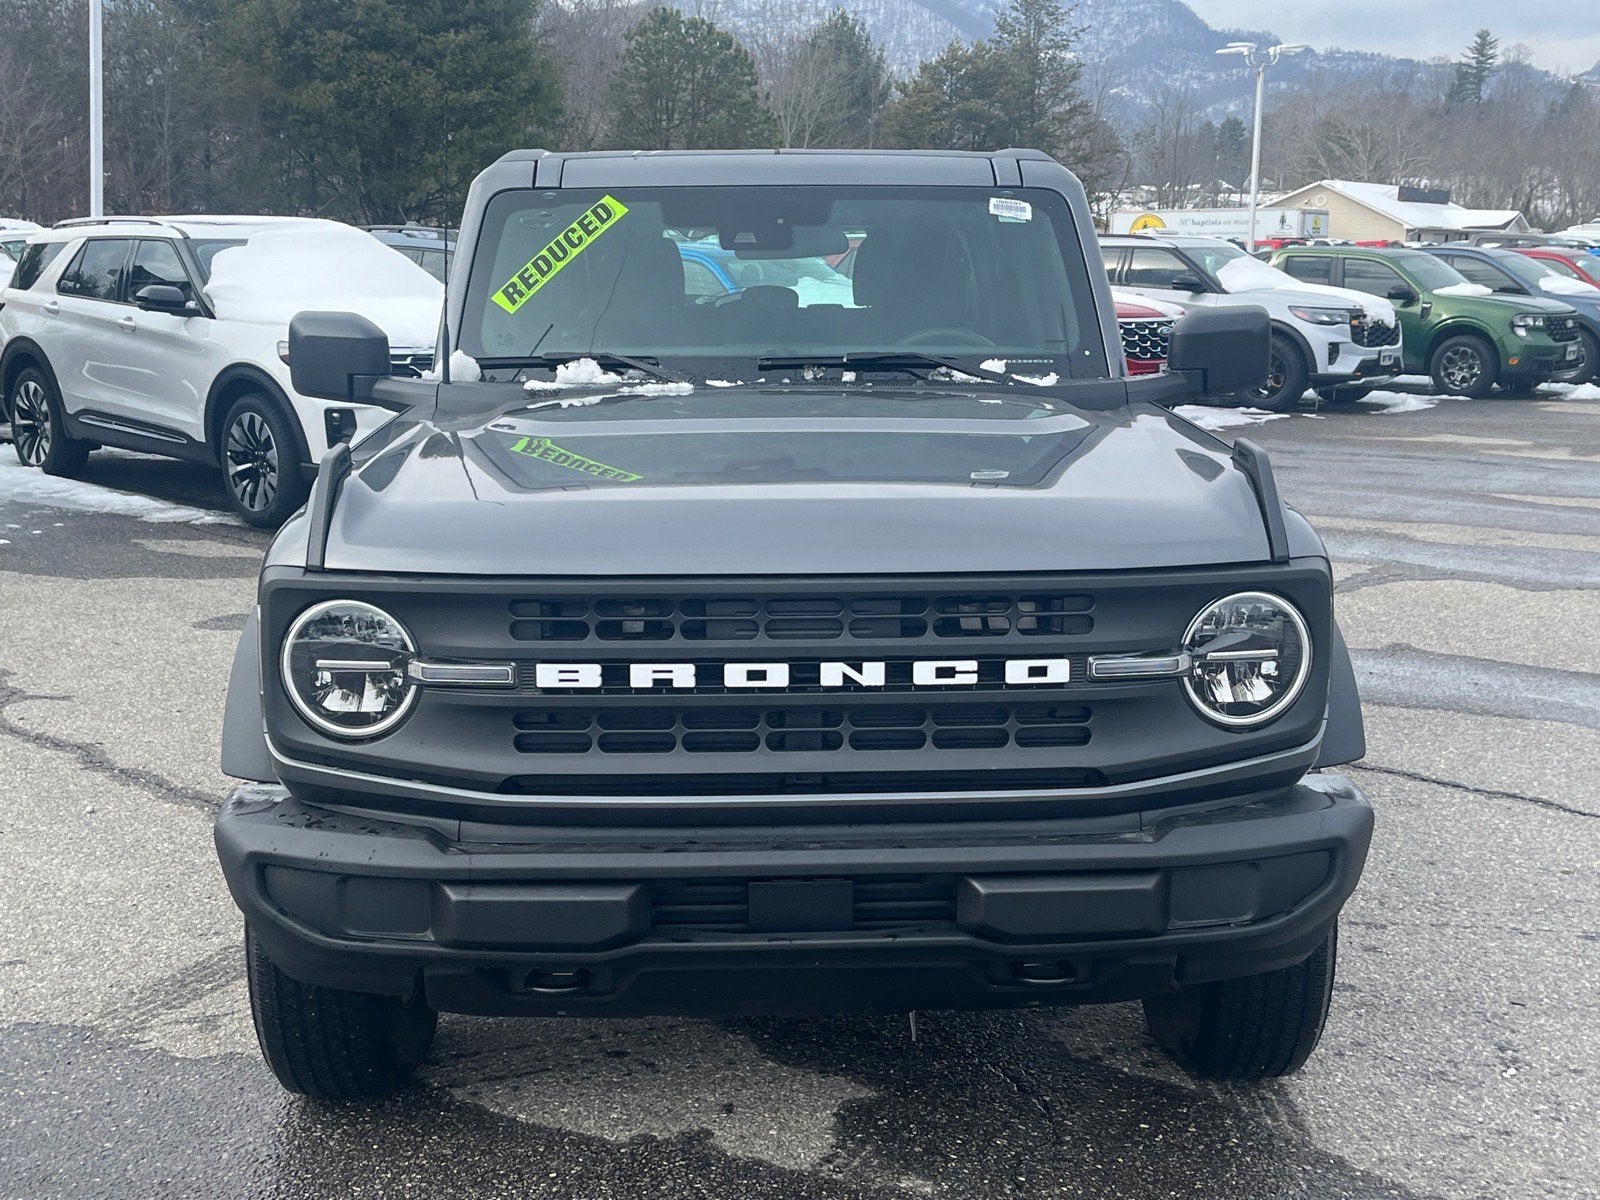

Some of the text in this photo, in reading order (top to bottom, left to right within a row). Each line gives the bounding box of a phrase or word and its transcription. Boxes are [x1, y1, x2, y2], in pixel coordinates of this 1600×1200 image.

[1191, 218, 1222, 227] baptists
[501, 202, 613, 306] REDUCED
[535, 658, 1071, 689] BRONCO
